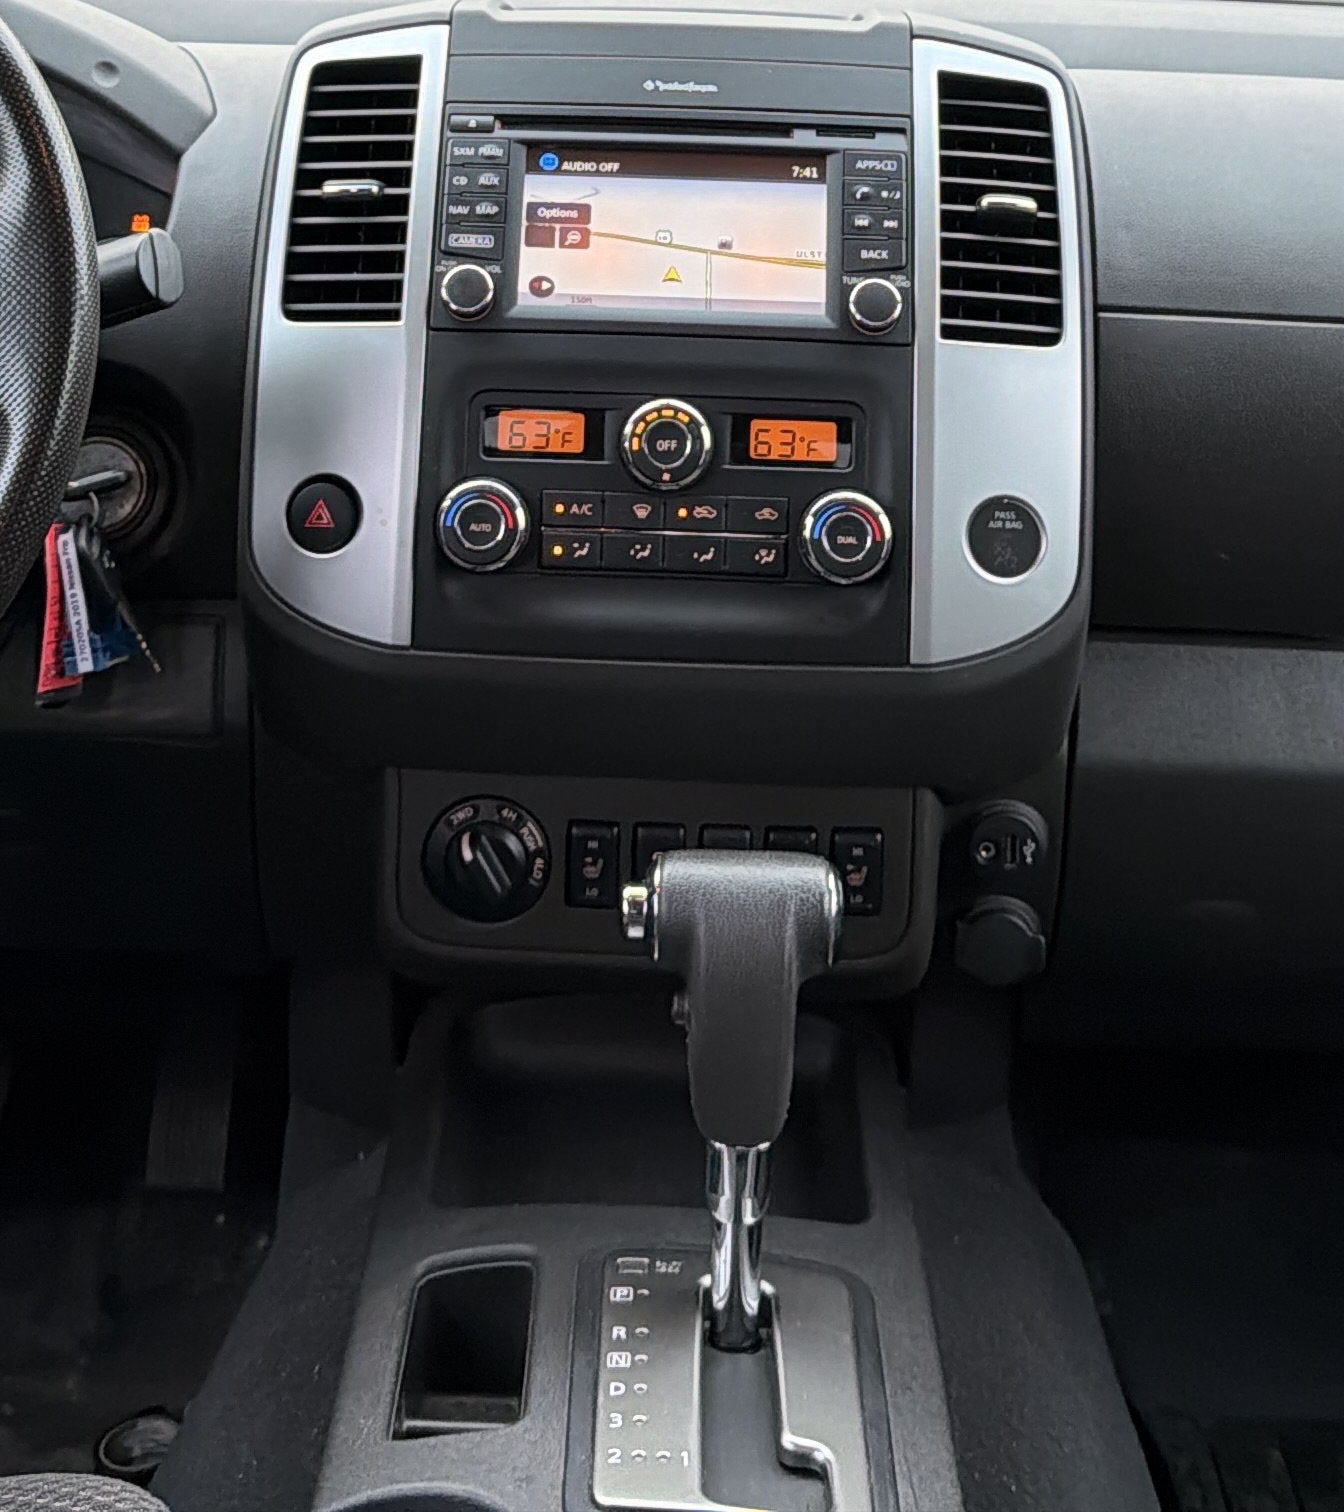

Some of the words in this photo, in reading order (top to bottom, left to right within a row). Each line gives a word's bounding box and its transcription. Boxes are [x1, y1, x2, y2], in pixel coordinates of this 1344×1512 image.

[453, 146, 475, 156] SXM
[561, 161, 597, 172] AUDIO
[599, 162, 620, 173] OFF
[791, 166, 819, 178] 7:41
[452, 176, 468, 186] CD
[478, 176, 500, 186] AUX
[448, 205, 470, 215] NAV
[475, 205, 500, 215] MAP
[537, 206, 578, 219] Options
[452, 235, 491, 246] CAMERA
[860, 249, 889, 260] BACK
[656, 439, 679, 452] OFF
[570, 503, 594, 516] A/C
[994, 511, 1016, 519] PASS
[469, 522, 493, 532] AUTO
[988, 520, 1003, 529] AIR
[1005, 520, 1024, 530] BAG
[836, 535, 859, 545] DUAL
[449, 806, 474, 826] 2WD
[501, 807, 518, 822] 4H
[519, 825, 536, 852] PUSH
[587, 839, 599, 849] HI
[852, 847, 864, 857] HI
[533, 856, 545, 879] 4LO
[585, 887, 598, 897] LO
[850, 895, 863, 904] LO
[612, 1325, 627, 1340] R
[609, 1381, 626, 1396] D
[609, 1412, 623, 1428] 3
[607, 1448, 622, 1464] 2
[681, 1450, 689, 1468] 1
